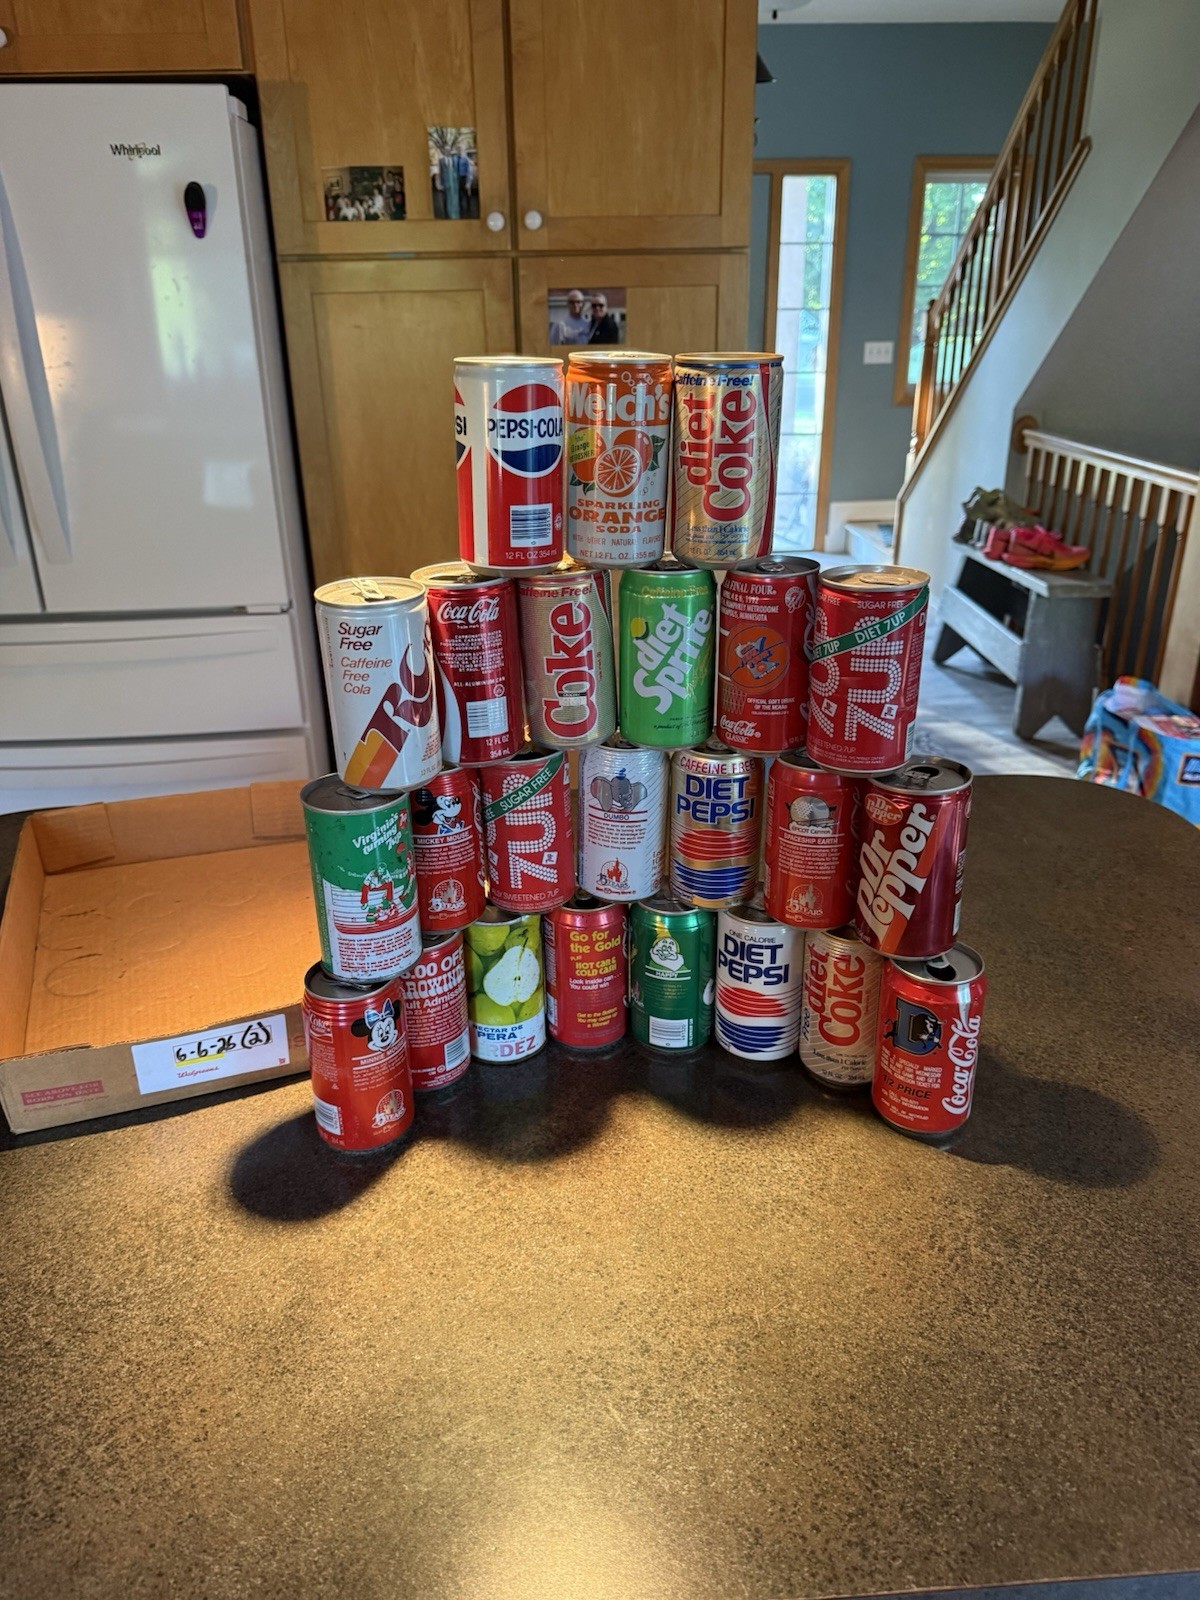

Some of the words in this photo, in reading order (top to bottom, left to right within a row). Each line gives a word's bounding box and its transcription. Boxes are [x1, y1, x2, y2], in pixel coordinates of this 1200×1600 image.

[110, 143, 161, 158] Whirlpool
[717, 373, 754, 387] Free!
[568, 381, 670, 422] Welch's
[680, 391, 715, 486] diet
[701, 387, 758, 522] Coke
[577, 498, 660, 510] SPARKLING
[568, 505, 665, 525] ORANGE
[595, 525, 642, 534] SODA
[505, 552, 514, 560] 12
[515, 551, 525, 560] FL
[527, 551, 538, 559] OZ
[579, 549, 594, 558] NET
[560, 583, 593, 598] Free!
[436, 596, 500, 625] Coca-Cola
[856, 600, 885, 610] SUGAR
[887, 599, 904, 609] FREE
[337, 621, 383, 639] Sugar
[632, 602, 692, 671] diet
[855, 624, 882, 644] DIET
[885, 611, 906, 632] 7UP
[339, 637, 373, 651] Free
[822, 641, 841, 656] 7UP
[340, 656, 393, 669] Caffeine
[542, 600, 598, 739] Coke
[632, 608, 713, 715] Sprite
[342, 669, 370, 682] Free
[343, 682, 372, 695] Cola
[485, 738, 493, 747] 12
[494, 737, 502, 745] FL
[490, 749, 502, 759] 354
[680, 756, 727, 775] CAFFEINE
[500, 786, 532, 812] SUGAR
[532, 767, 553, 789] FREE
[685, 773, 750, 801] DIET
[603, 812, 630, 821] DUMBO
[676, 793, 755, 825] PEPSI
[352, 812, 399, 849] Virginia's
[416, 836, 445, 845] MICKEY
[446, 829, 470, 842] MOUSE
[783, 832, 817, 844] SPACESHIP
[859, 829, 892, 891] Dr
[857, 803, 936, 944] Pepper
[569, 930, 589, 943] Go
[592, 929, 610, 942] for
[569, 943, 591, 954] the
[594, 934, 621, 953] Gold
[729, 929, 743, 939] ONE
[744, 934, 776, 944] CALORIE
[724, 932, 784, 965] DIET
[575, 961, 594, 970] HOT
[575, 968, 598, 977] COLD
[655, 970, 679, 978] HAPPY
[718, 948, 790, 986] PEPSI
[804, 943, 830, 1014] diet
[818, 953, 866, 1047] Coke
[176, 1035, 236, 1061] 6-6-26
[241, 1021, 271, 1049] (2)
[477, 1031, 517, 1041] PERA
[941, 1014, 981, 1115] Coca-Cola
[882, 1075, 895, 1088] 1/2
[897, 1083, 932, 1099] PRICE
